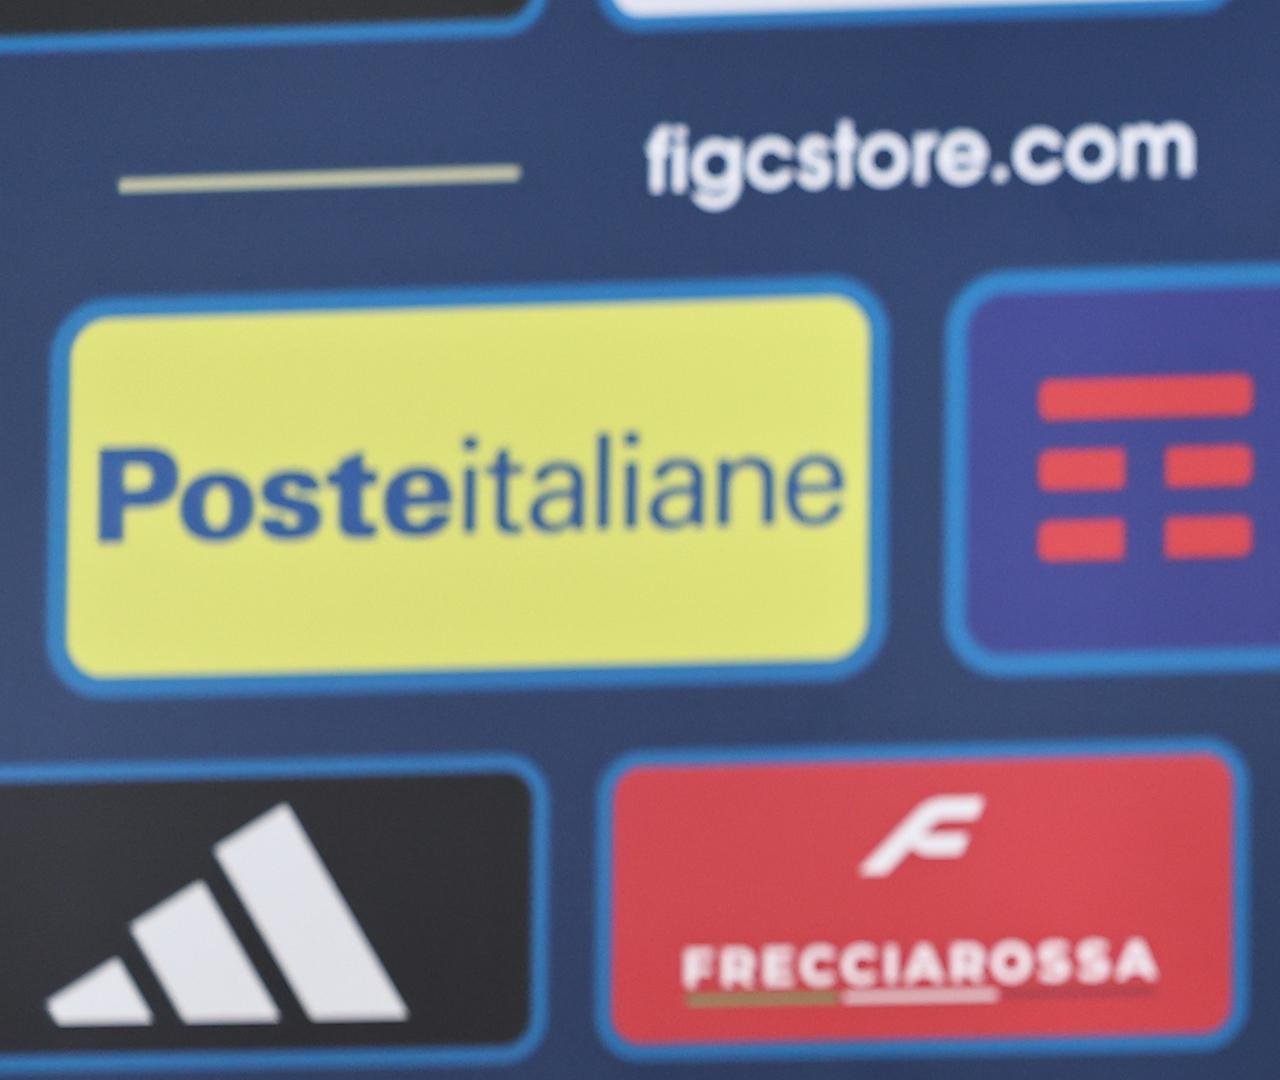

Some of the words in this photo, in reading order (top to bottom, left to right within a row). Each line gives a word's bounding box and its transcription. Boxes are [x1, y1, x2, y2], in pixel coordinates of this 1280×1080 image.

[643, 117, 1197, 213] figcstore.com
[96, 432, 846, 544] Posteitaliane
[680, 936, 1160, 992] FRECCIAROSSA
